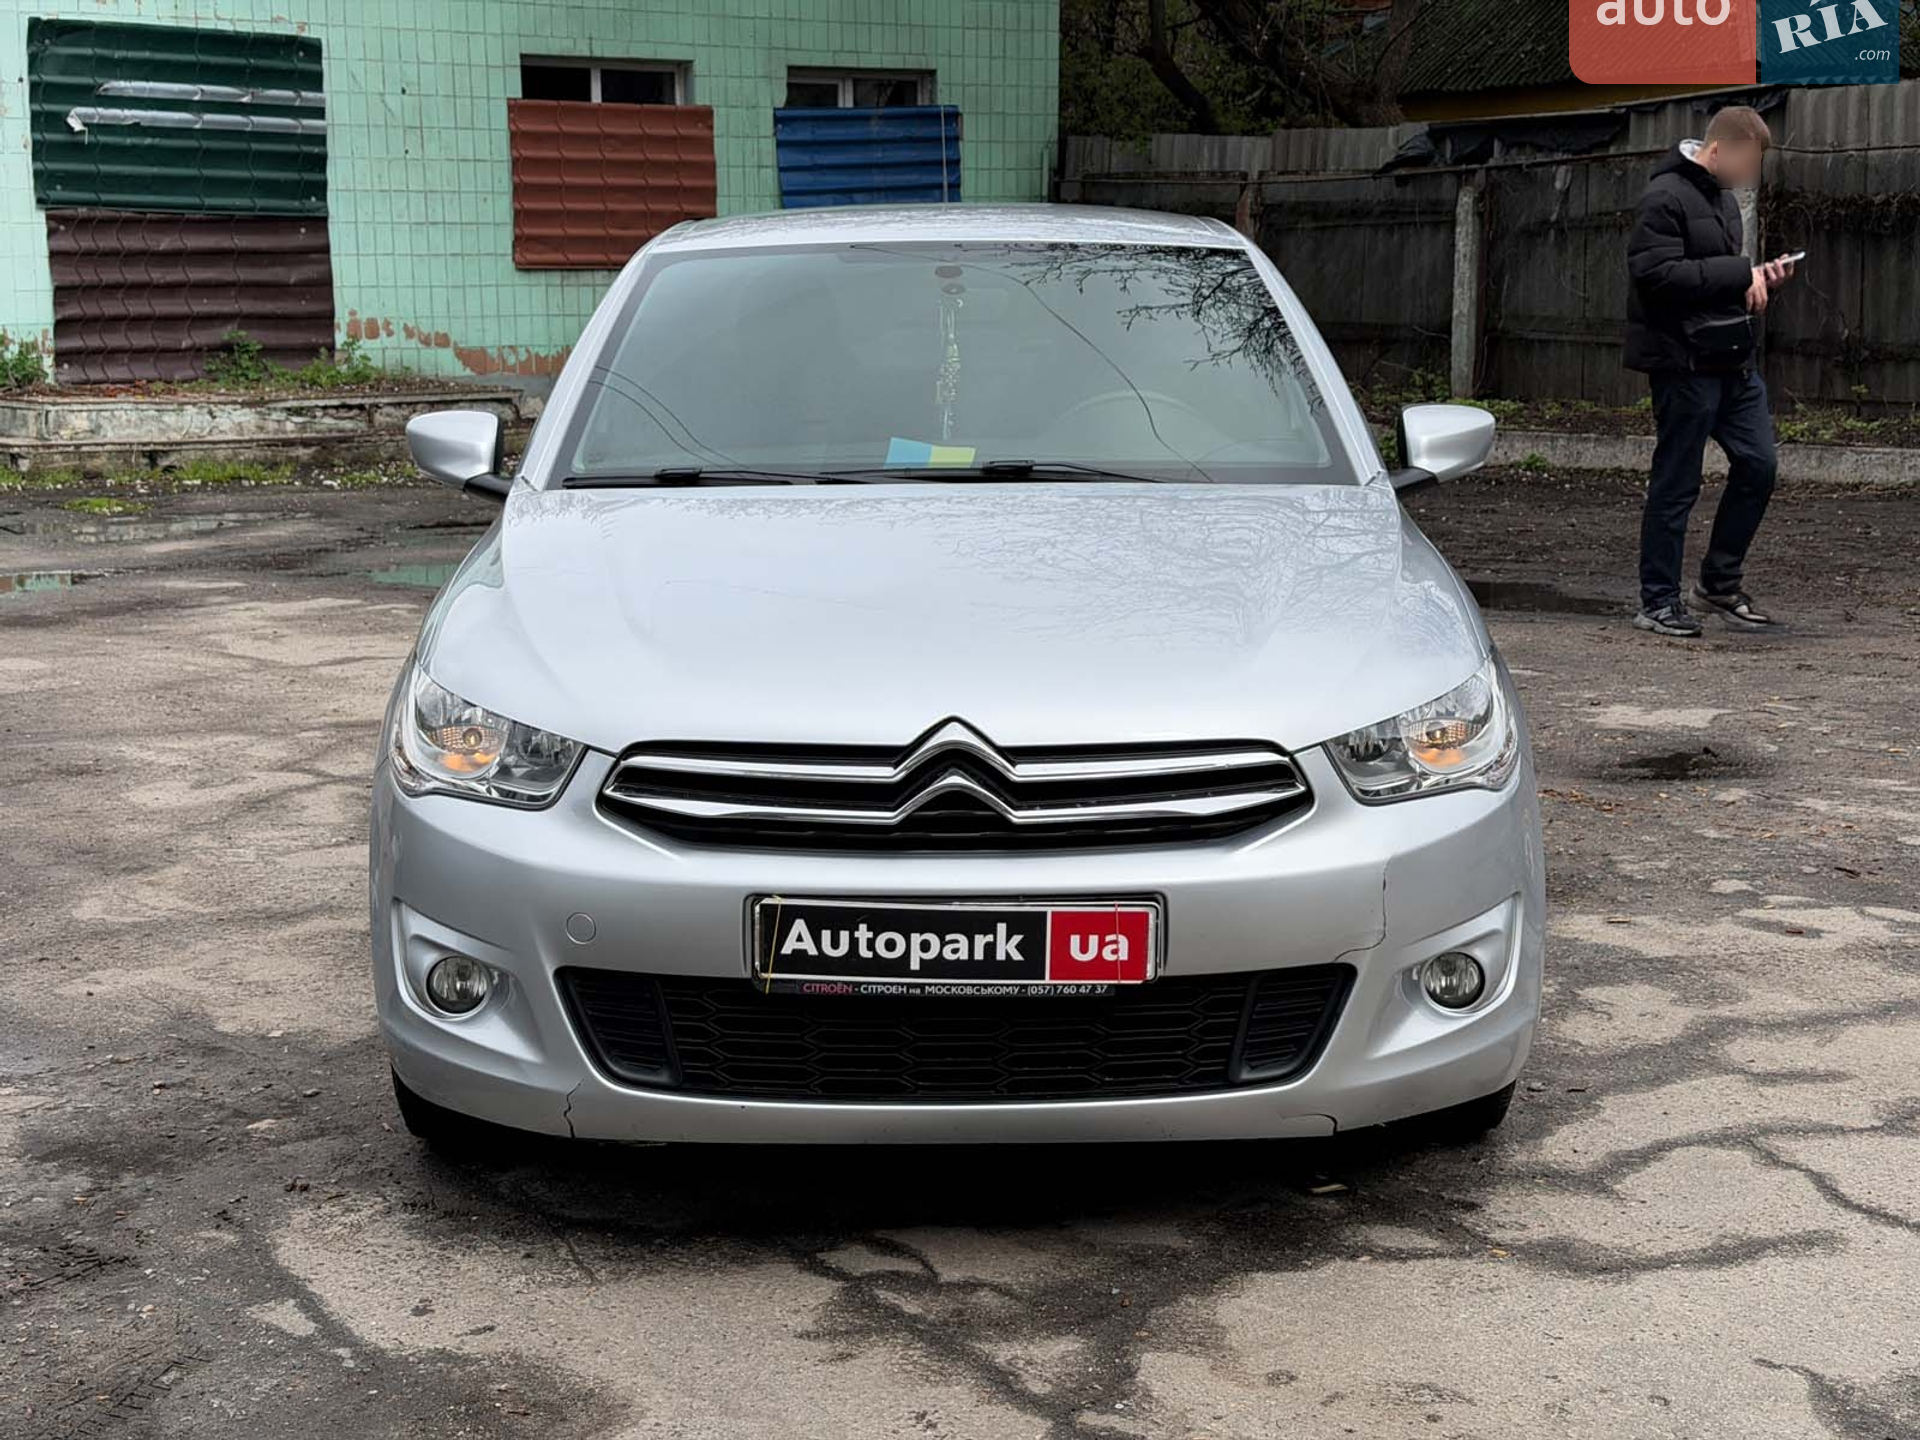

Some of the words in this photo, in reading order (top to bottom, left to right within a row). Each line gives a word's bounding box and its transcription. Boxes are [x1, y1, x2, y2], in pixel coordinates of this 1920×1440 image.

[780, 918, 1025, 971] Autopark
[1069, 933, 1130, 962] ua
[924, 985, 1020, 996] МОСКОВСЬКОМУ
[1027, 985, 1055, 996] (057)
[1056, 985, 1077, 995] 760
[1078, 985, 1091, 995] 47
[1094, 985, 1108, 995] 37
